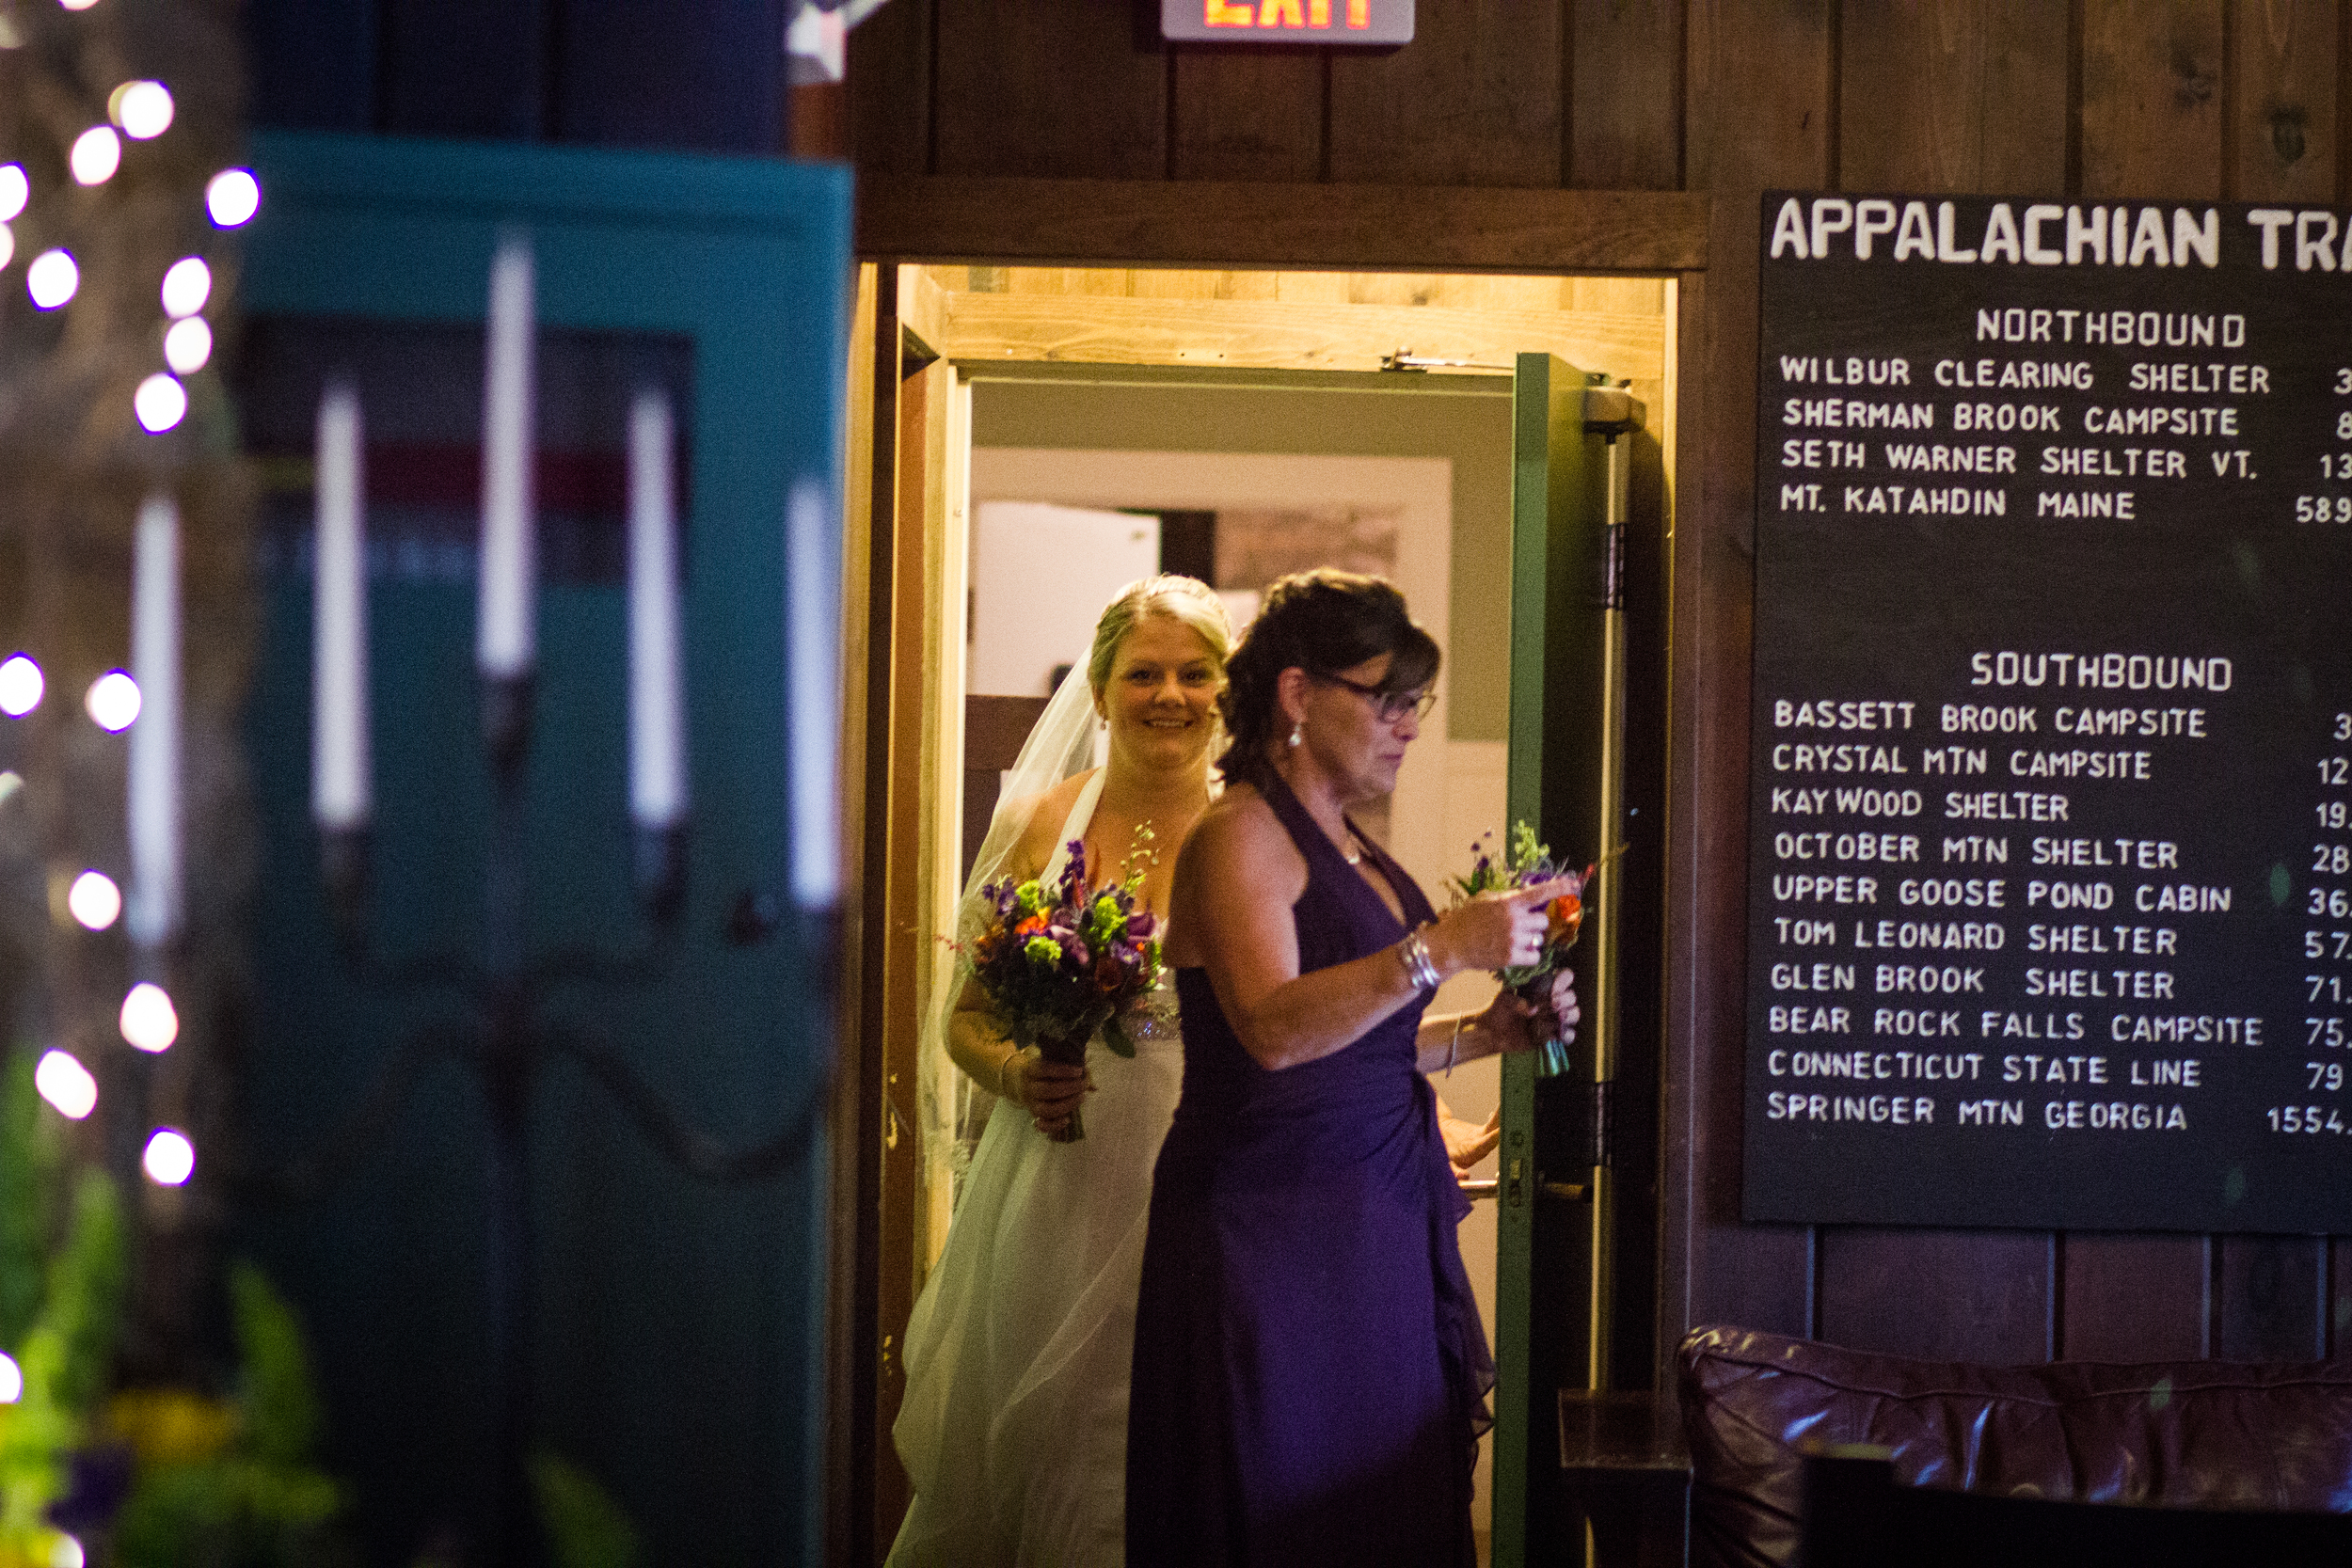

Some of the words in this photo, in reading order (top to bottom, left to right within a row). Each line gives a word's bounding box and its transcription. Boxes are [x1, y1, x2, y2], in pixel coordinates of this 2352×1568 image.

[1770, 198, 2219, 268] APPALACHIAN
[1976, 308, 2246, 348] NORTHBOUND
[1779, 355, 1911, 386] WILBUR
[1933, 358, 2094, 390] CLEARING
[2128, 362, 2270, 394] SHELTER
[1782, 397, 1934, 430] SHERMAN
[1953, 402, 2061, 433] BROOK
[2084, 405, 2239, 436] CAMPSITE
[1781, 438, 1866, 469] SETH
[1884, 443, 2017, 474] WARNER
[2040, 446, 2187, 479] SHELTER
[2211, 450, 2257, 480] VT.
[1780, 483, 1827, 513] MT.
[1844, 485, 2007, 516] KATAHDIN
[2037, 491, 2136, 520] MAINE
[1970, 651, 2233, 692] SOUTHBOUND
[1773, 699, 1915, 731] BASSETT
[1941, 704, 2038, 733] BROOK
[2055, 706, 2207, 738] CAMPSITE
[1772, 743, 1908, 774] CRYSTAL
[1923, 745, 1987, 775] MTN
[2010, 749, 2152, 780] CAMPSITE
[2317, 756, 2349, 785] 12
[1945, 791, 2069, 822] SHELTER
[1774, 832, 1920, 863] OCTOBER
[1942, 835, 2009, 863] MTN
[2031, 836, 2178, 870] SHELTER
[1772, 874, 1878, 904] UPPER
[1899, 879, 2006, 909] GOOSE
[2027, 879, 2114, 911] POND
[2135, 884, 2232, 912] CABIN
[1773, 916, 1836, 945] TOM
[1854, 920, 2005, 951] LEONARD
[2027, 924, 2177, 956] SHELTER
[1771, 962, 1855, 991] GLEN
[1875, 964, 1984, 993] BROOK
[2025, 967, 2174, 1000] SHELTER
[1769, 1006, 1851, 1035] BEAR
[1873, 1007, 1961, 1037] ROCK
[1981, 1010, 2085, 1040] FALLS
[2111, 1014, 2263, 1046] CAMPSITE
[1768, 1049, 1984, 1080] CONNECTICUT
[2002, 1054, 2108, 1085] STATE
[2130, 1059, 2201, 1087] LINE
[2306, 1062, 2343, 1091] 79
[1767, 1091, 1935, 1125] SPRINGER
[1958, 1099, 2024, 1126] MTN
[2044, 1101, 2187, 1130] GEORGIA
